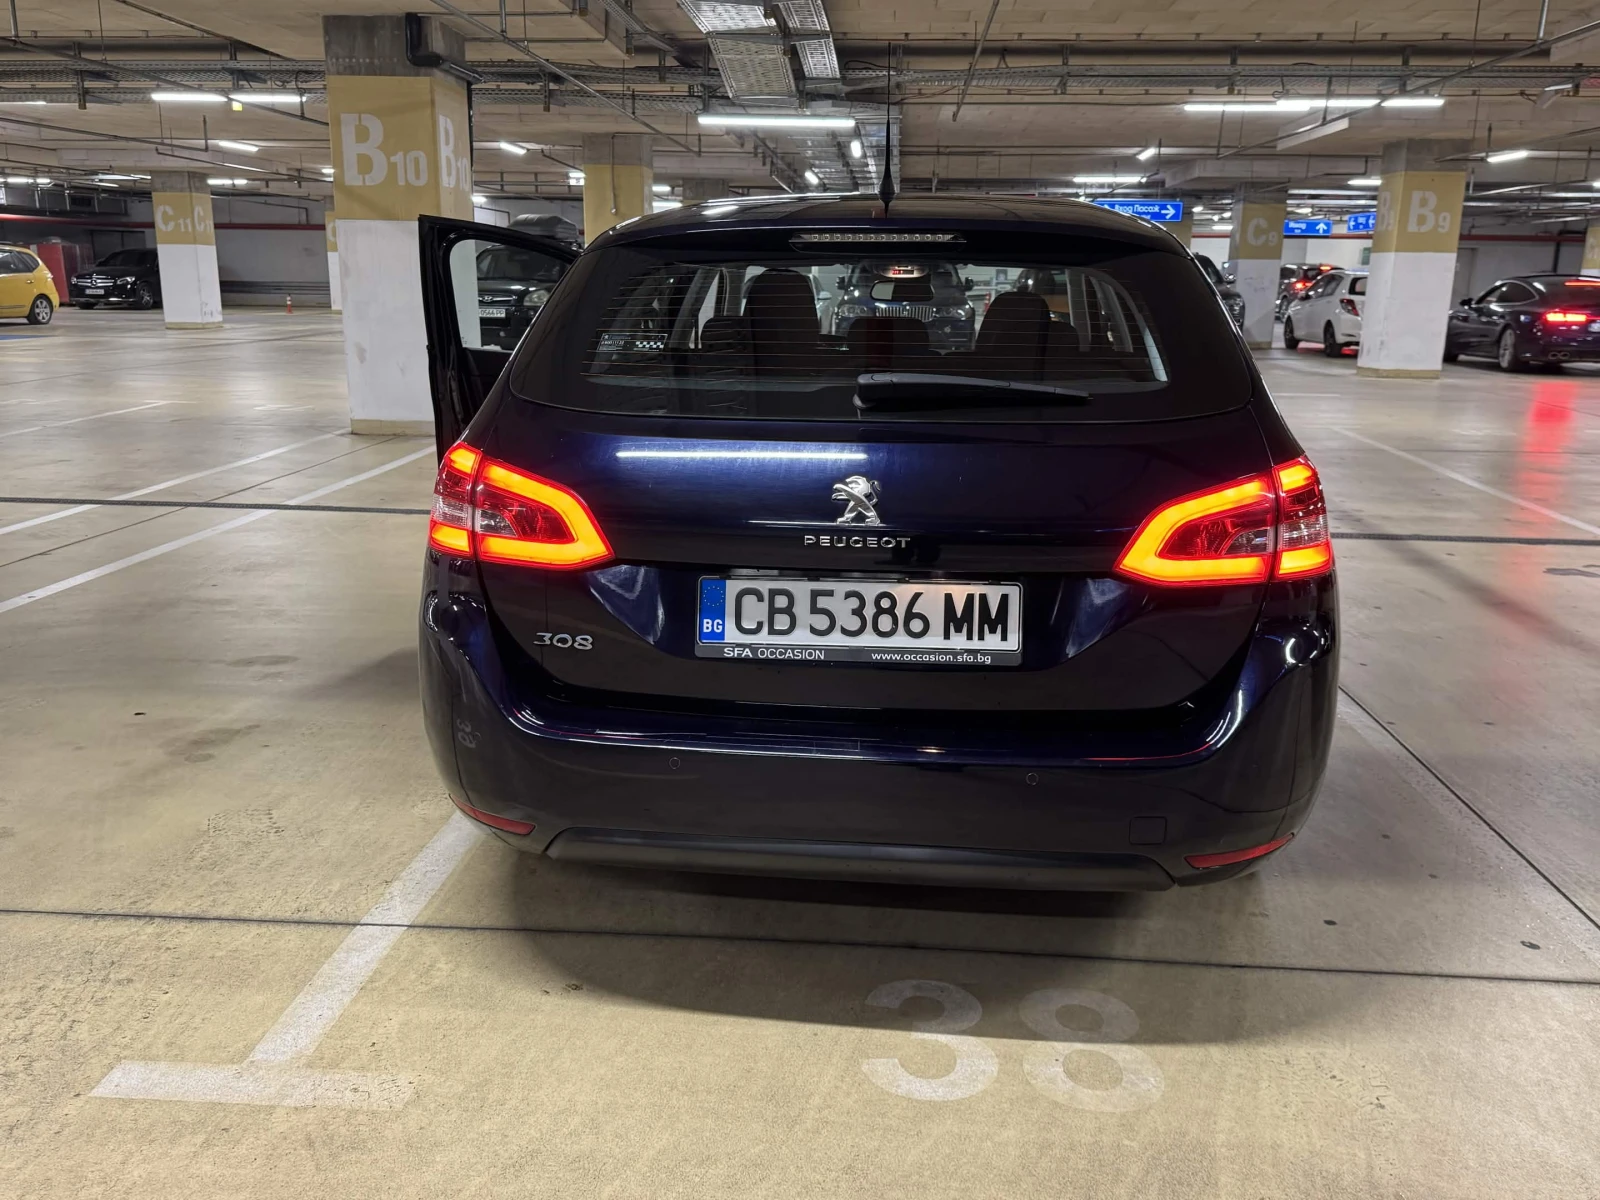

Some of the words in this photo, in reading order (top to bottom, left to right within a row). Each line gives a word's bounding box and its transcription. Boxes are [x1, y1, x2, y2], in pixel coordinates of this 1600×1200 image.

[1407, 190, 1452, 234] B9
[803, 535, 911, 548] PEUGEOT
[734, 587, 797, 636] CB
[809, 589, 931, 639] 5386
[943, 592, 1009, 642] MM
[703, 618, 723, 634] BG
[533, 632, 593, 650] 308
[723, 647, 753, 658] SFA
[757, 648, 825, 660] OCCASION
[871, 653, 992, 664] www.occasion.sfa.bg
[861, 978, 1166, 1114] 38
